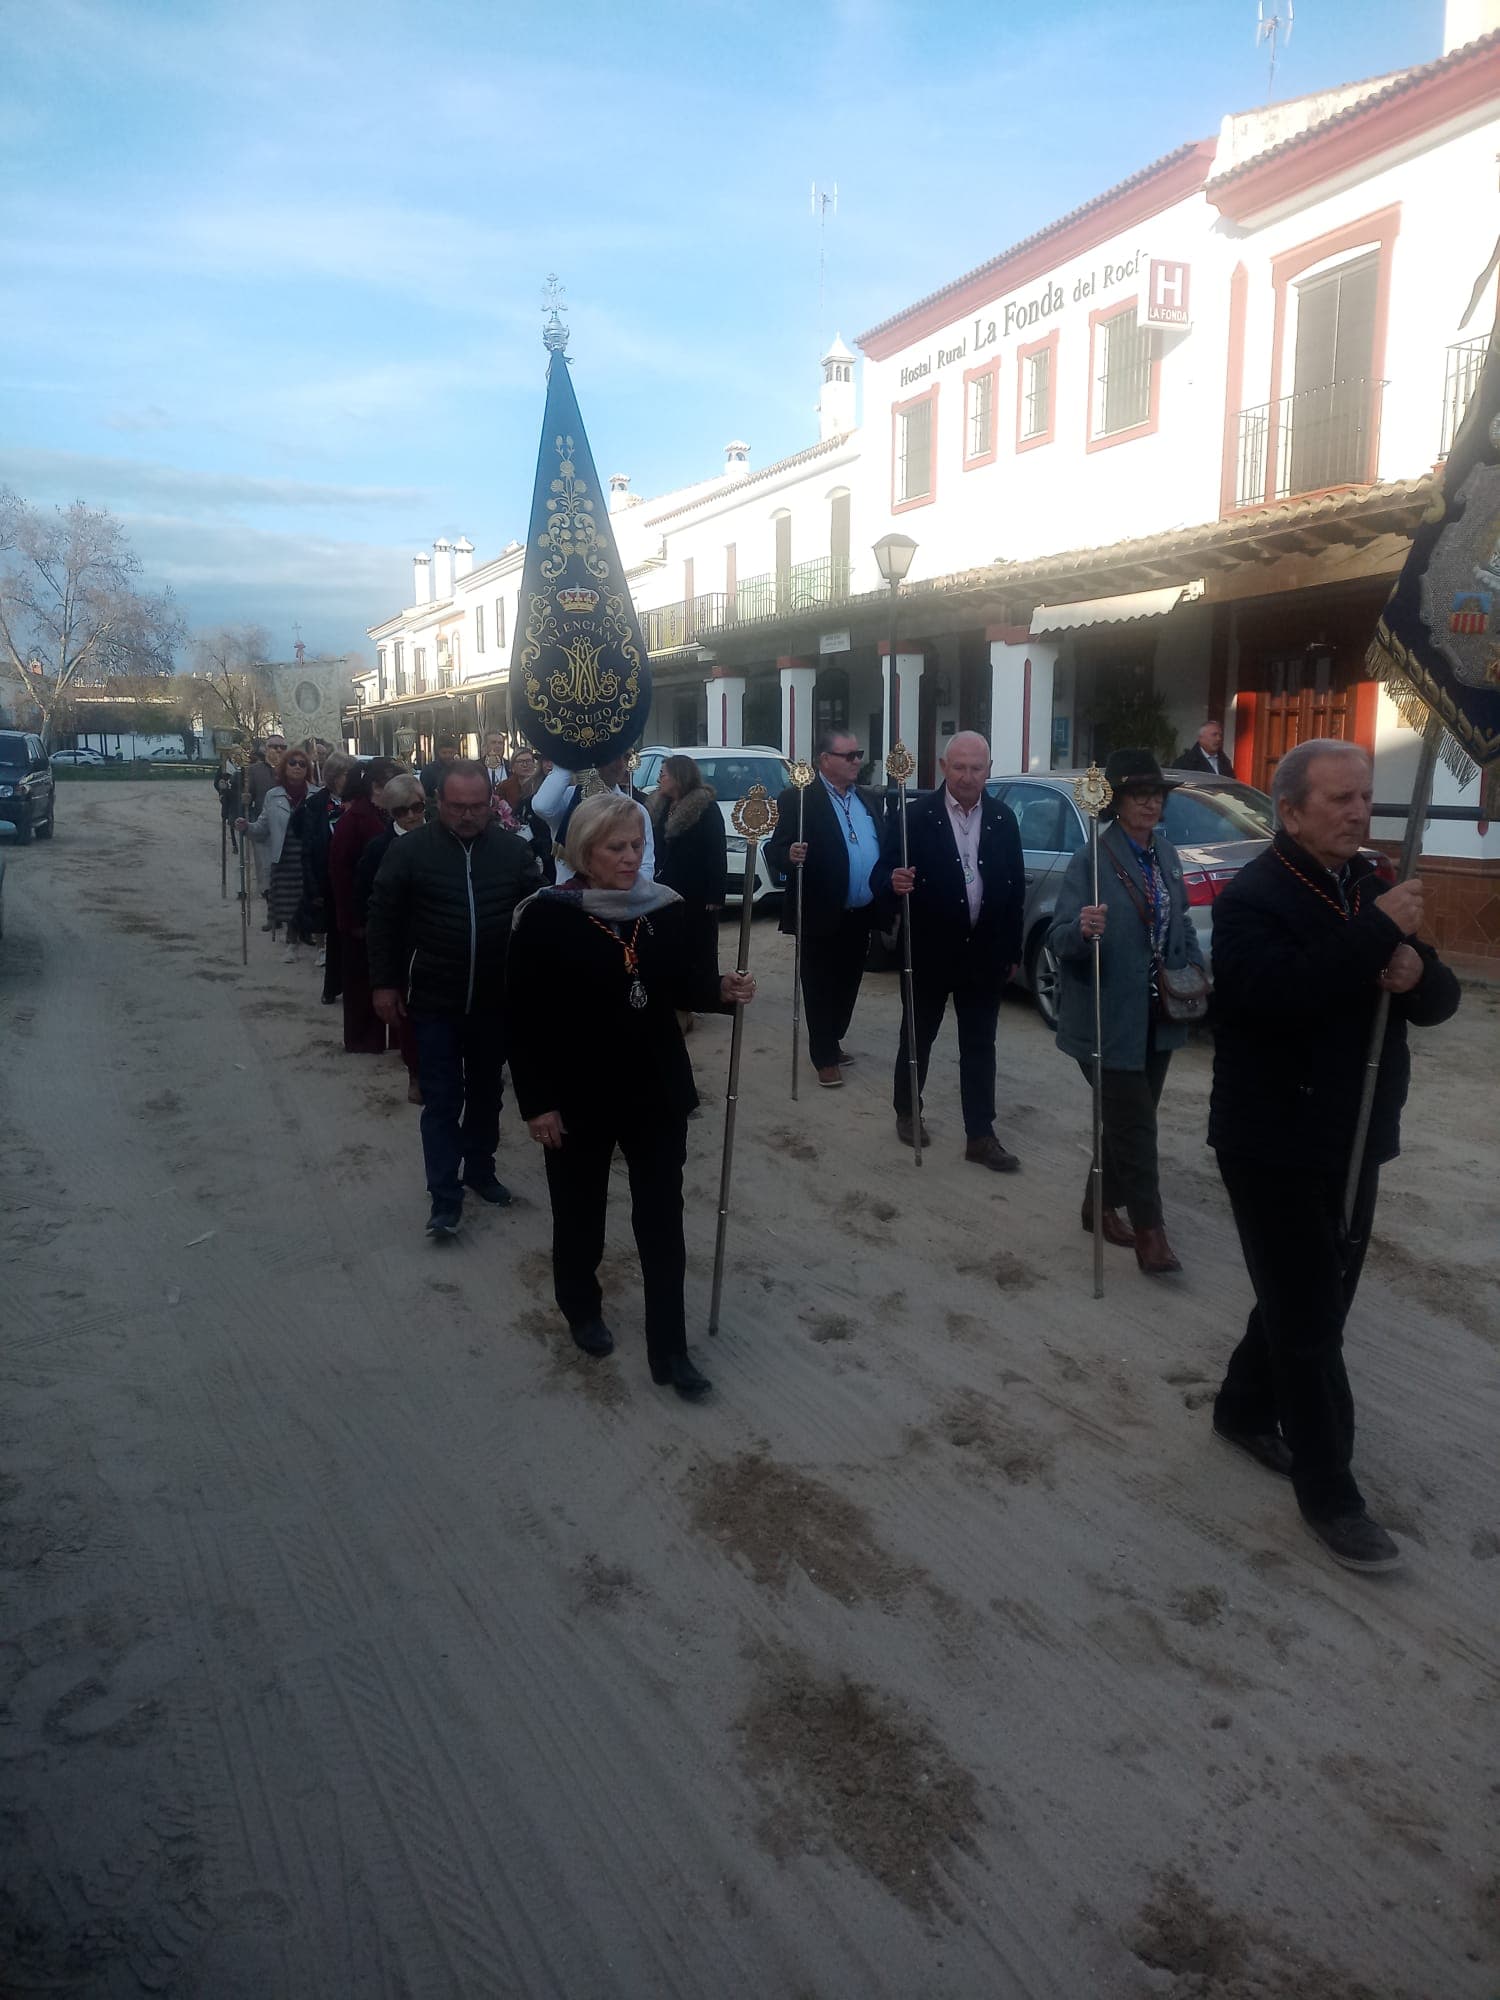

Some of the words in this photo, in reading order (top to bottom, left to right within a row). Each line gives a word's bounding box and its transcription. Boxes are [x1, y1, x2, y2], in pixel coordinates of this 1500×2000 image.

[1156, 265, 1183, 307] H
[900, 354, 931, 388] Hostal
[937, 336, 966, 369] Rural
[974, 318, 997, 352] La
[1003, 280, 1065, 338] Fonda
[1072, 271, 1096, 303] del
[1103, 248, 1149, 289] Rocí
[1161, 308, 1189, 322] FONDA
[558, 706, 575, 720] DE
[575, 706, 612, 724] CULTO
